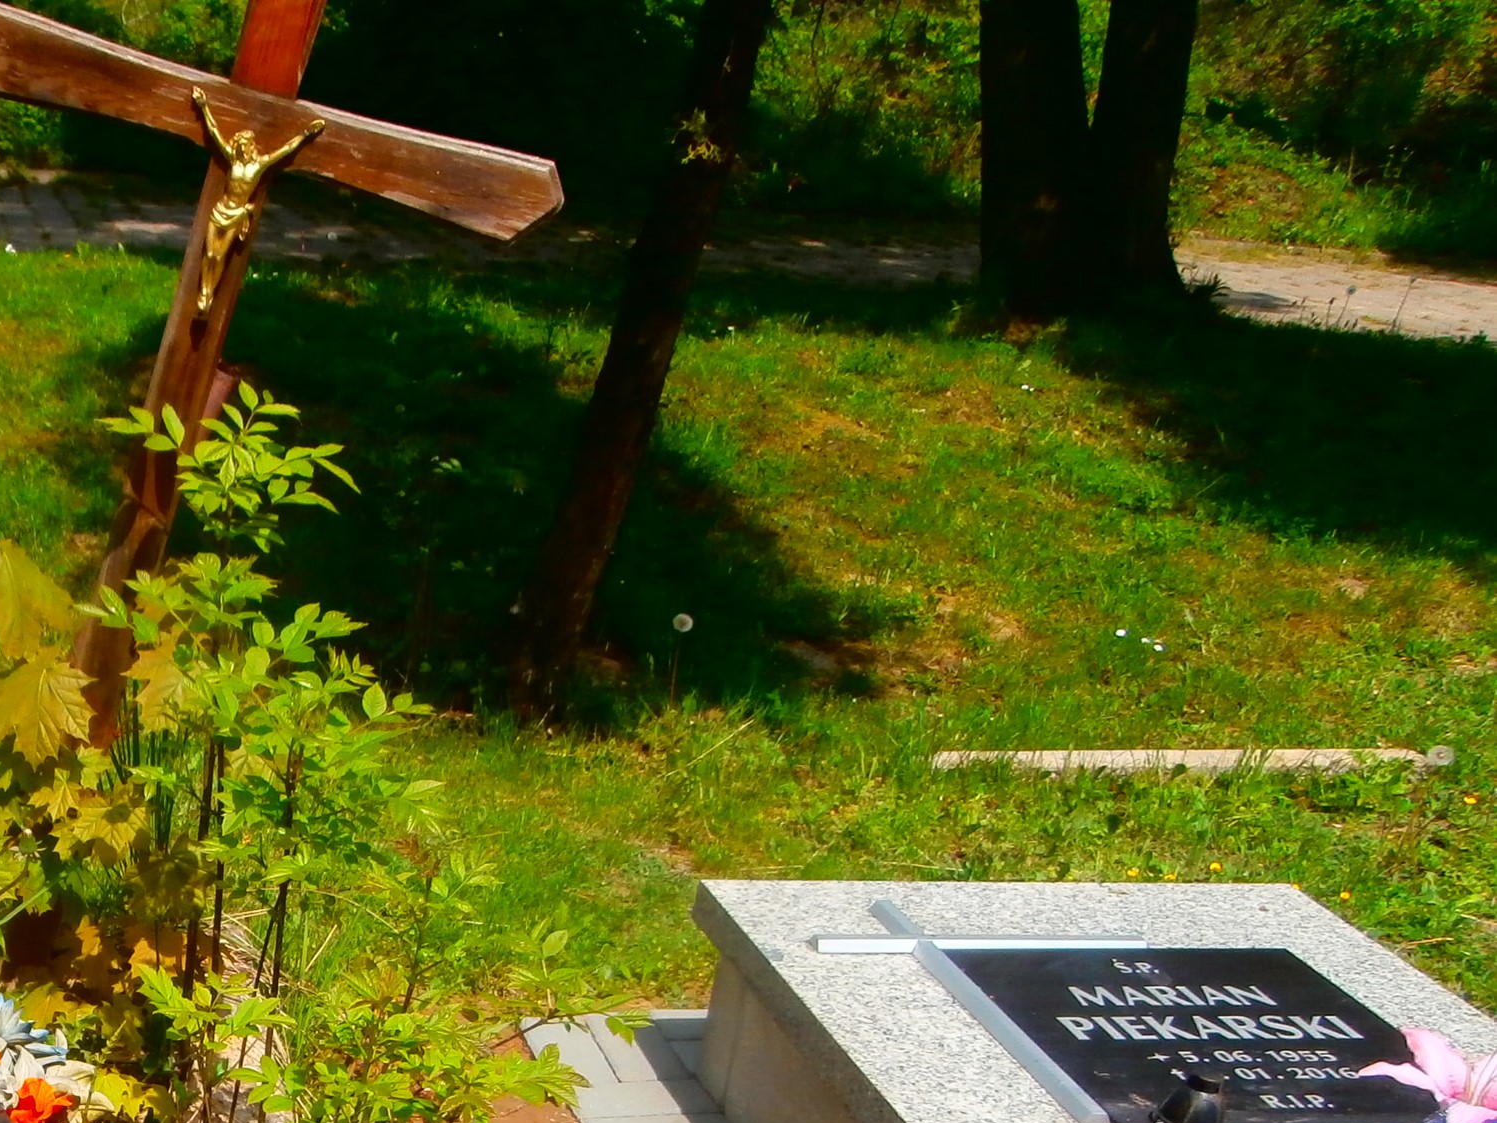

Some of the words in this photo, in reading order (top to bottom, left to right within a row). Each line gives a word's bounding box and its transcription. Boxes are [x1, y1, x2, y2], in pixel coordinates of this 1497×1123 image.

[1067, 985, 1278, 1007] MARIAN
[1055, 1015, 1365, 1041] PIEKARSKI
[1259, 1093, 1336, 1110] R.I.P.
